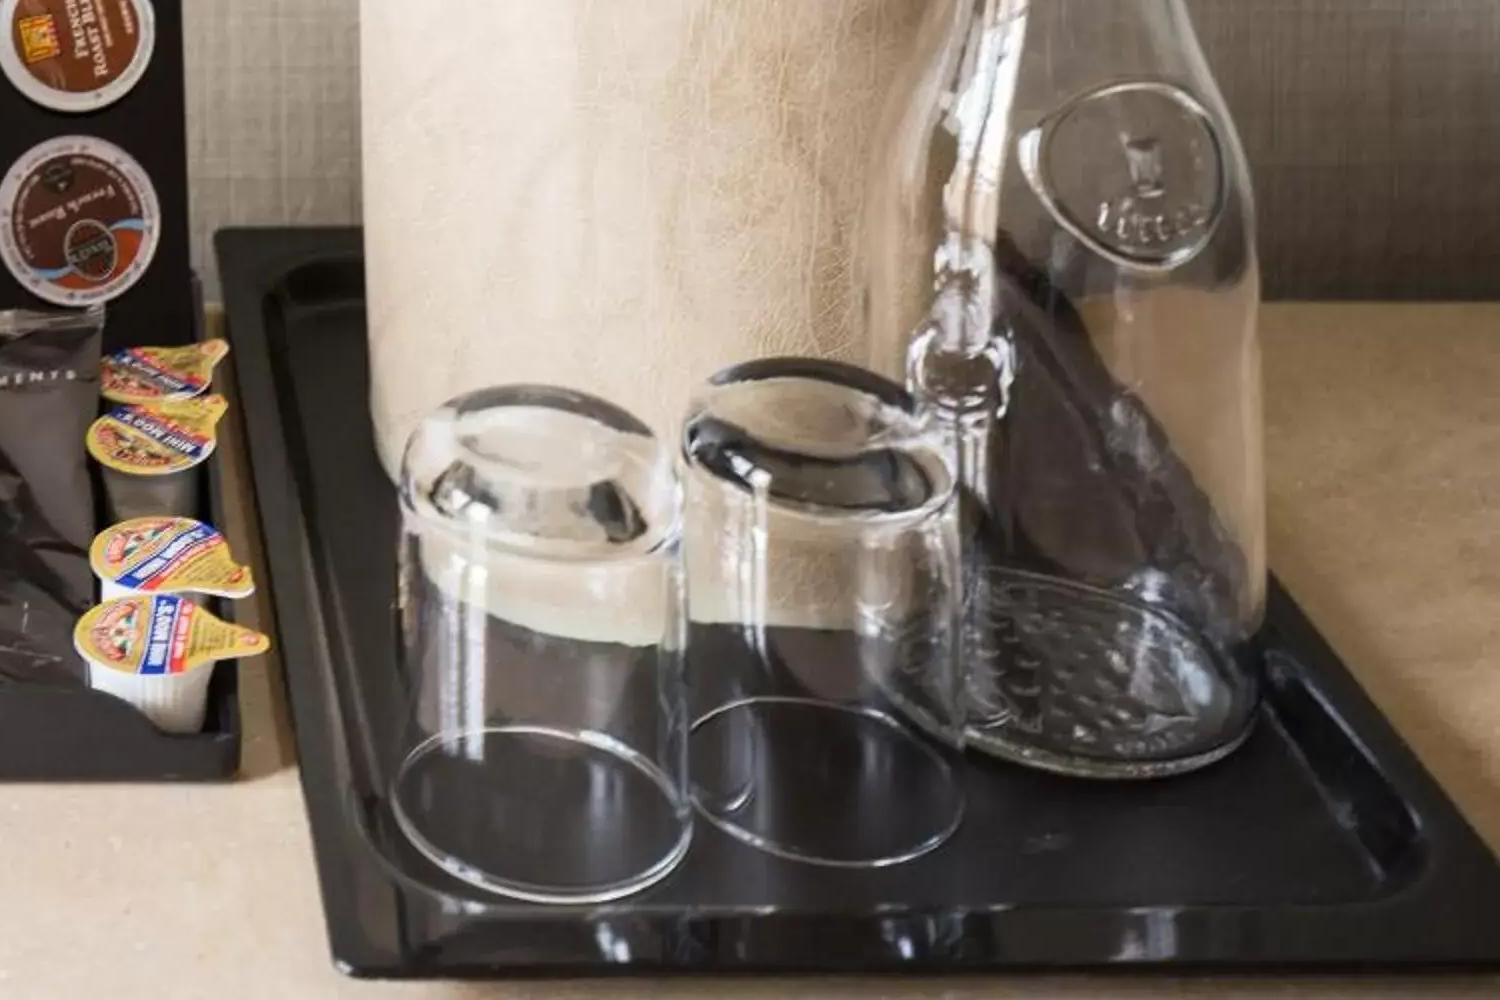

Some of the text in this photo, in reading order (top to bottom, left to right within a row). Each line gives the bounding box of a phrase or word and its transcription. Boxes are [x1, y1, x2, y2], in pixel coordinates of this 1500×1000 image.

[86, 26, 109, 78] ROAST
[66, 183, 116, 214] French
[162, 434, 198, 454] MINI
